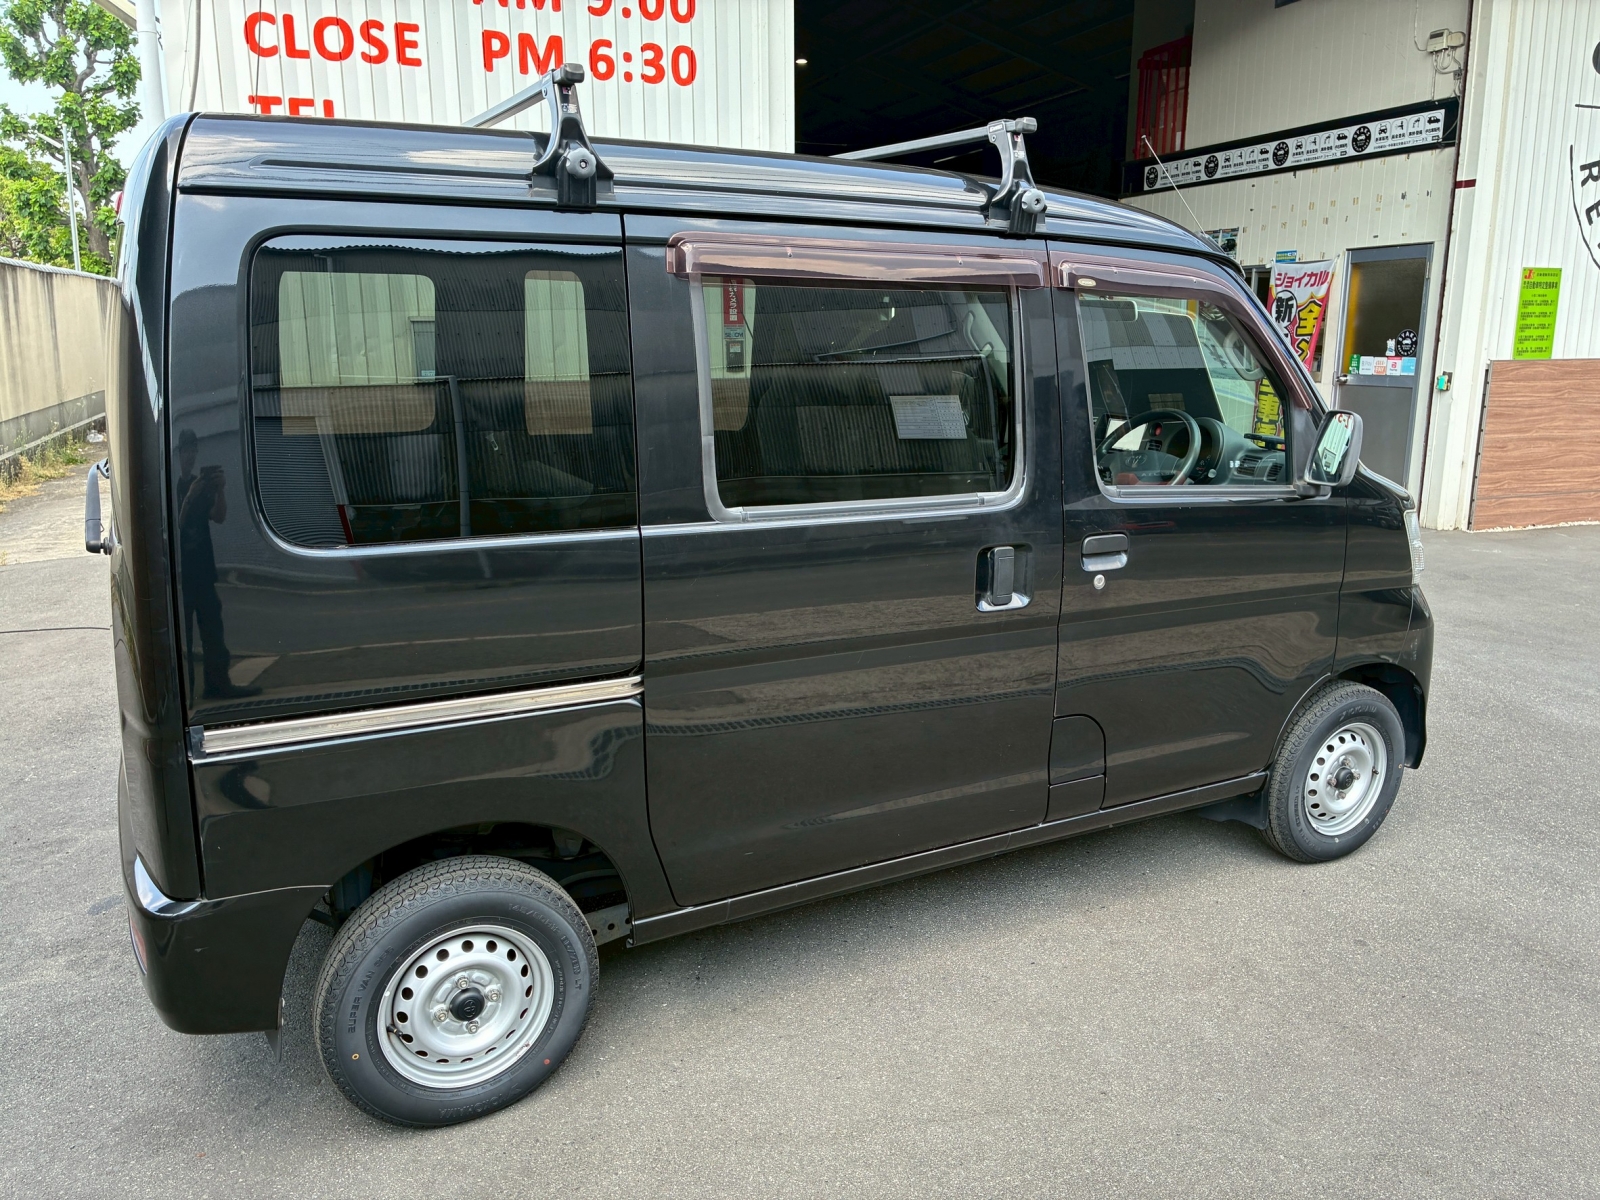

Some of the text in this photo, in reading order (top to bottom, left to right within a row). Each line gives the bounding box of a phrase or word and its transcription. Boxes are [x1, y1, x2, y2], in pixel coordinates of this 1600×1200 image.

[243, 11, 698, 87] CLOSE PM 6:30
[1275, 270, 1329, 289] ジョイカル
[1397, 331, 1417, 342] SYAKS
